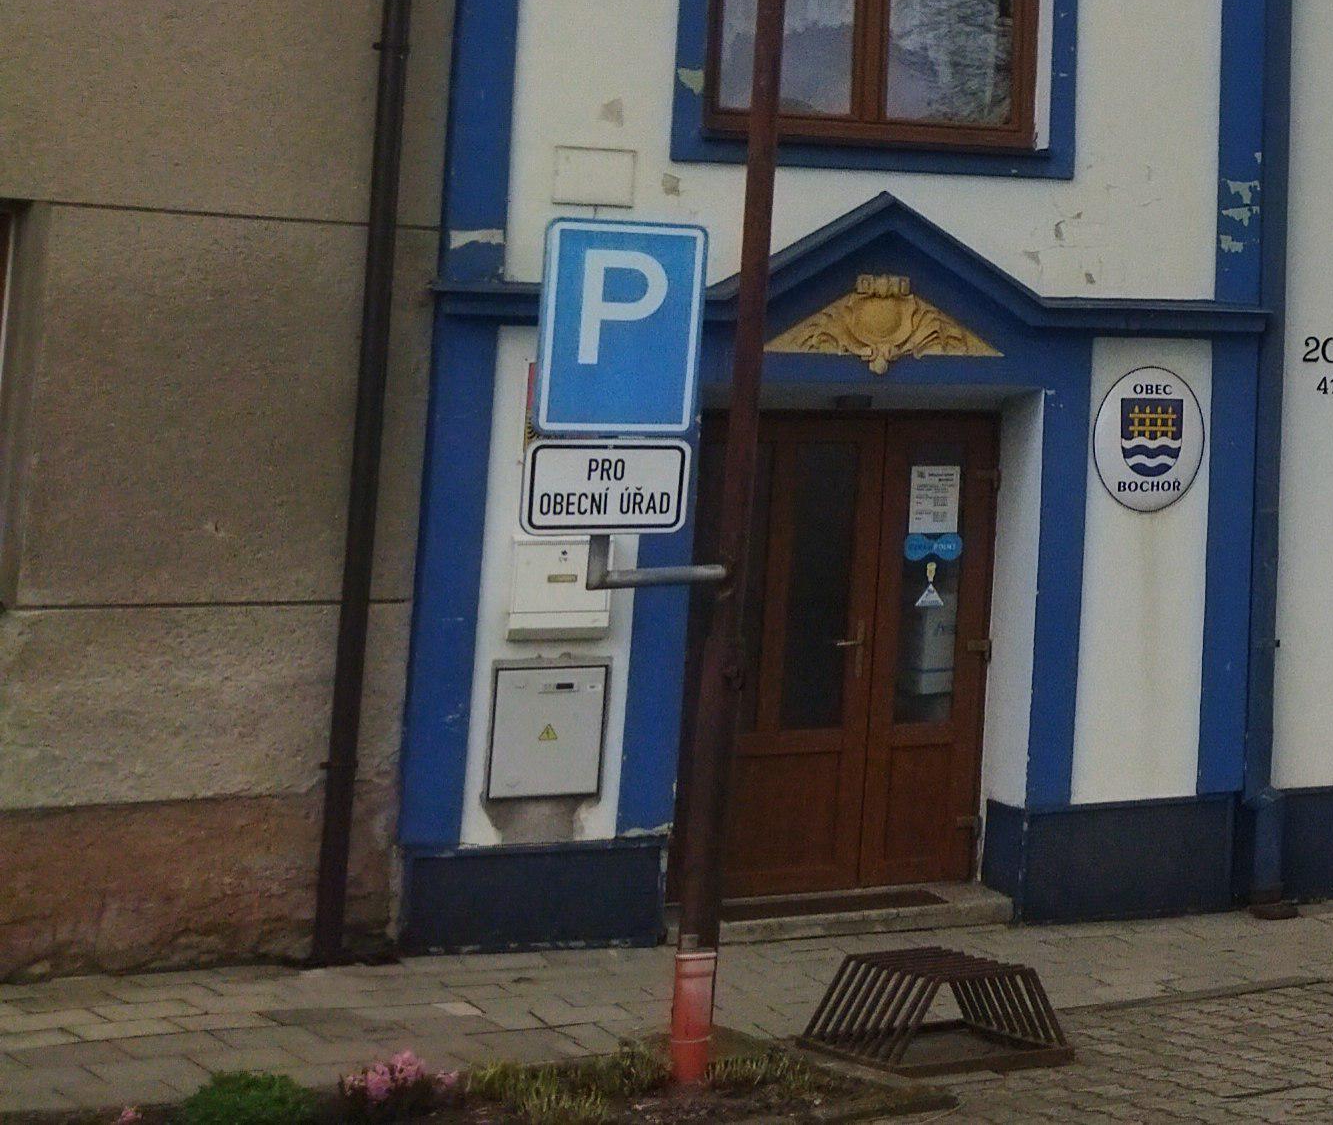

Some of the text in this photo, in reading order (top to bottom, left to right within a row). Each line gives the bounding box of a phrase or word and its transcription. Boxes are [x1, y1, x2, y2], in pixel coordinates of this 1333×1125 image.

[577, 249, 668, 364] P
[1133, 384, 1173, 395] OBEC
[587, 458, 626, 481] PRO
[1117, 478, 1181, 492] BOCHOŘ
[539, 486, 671, 516] OBECNÍ ÚŘAD
